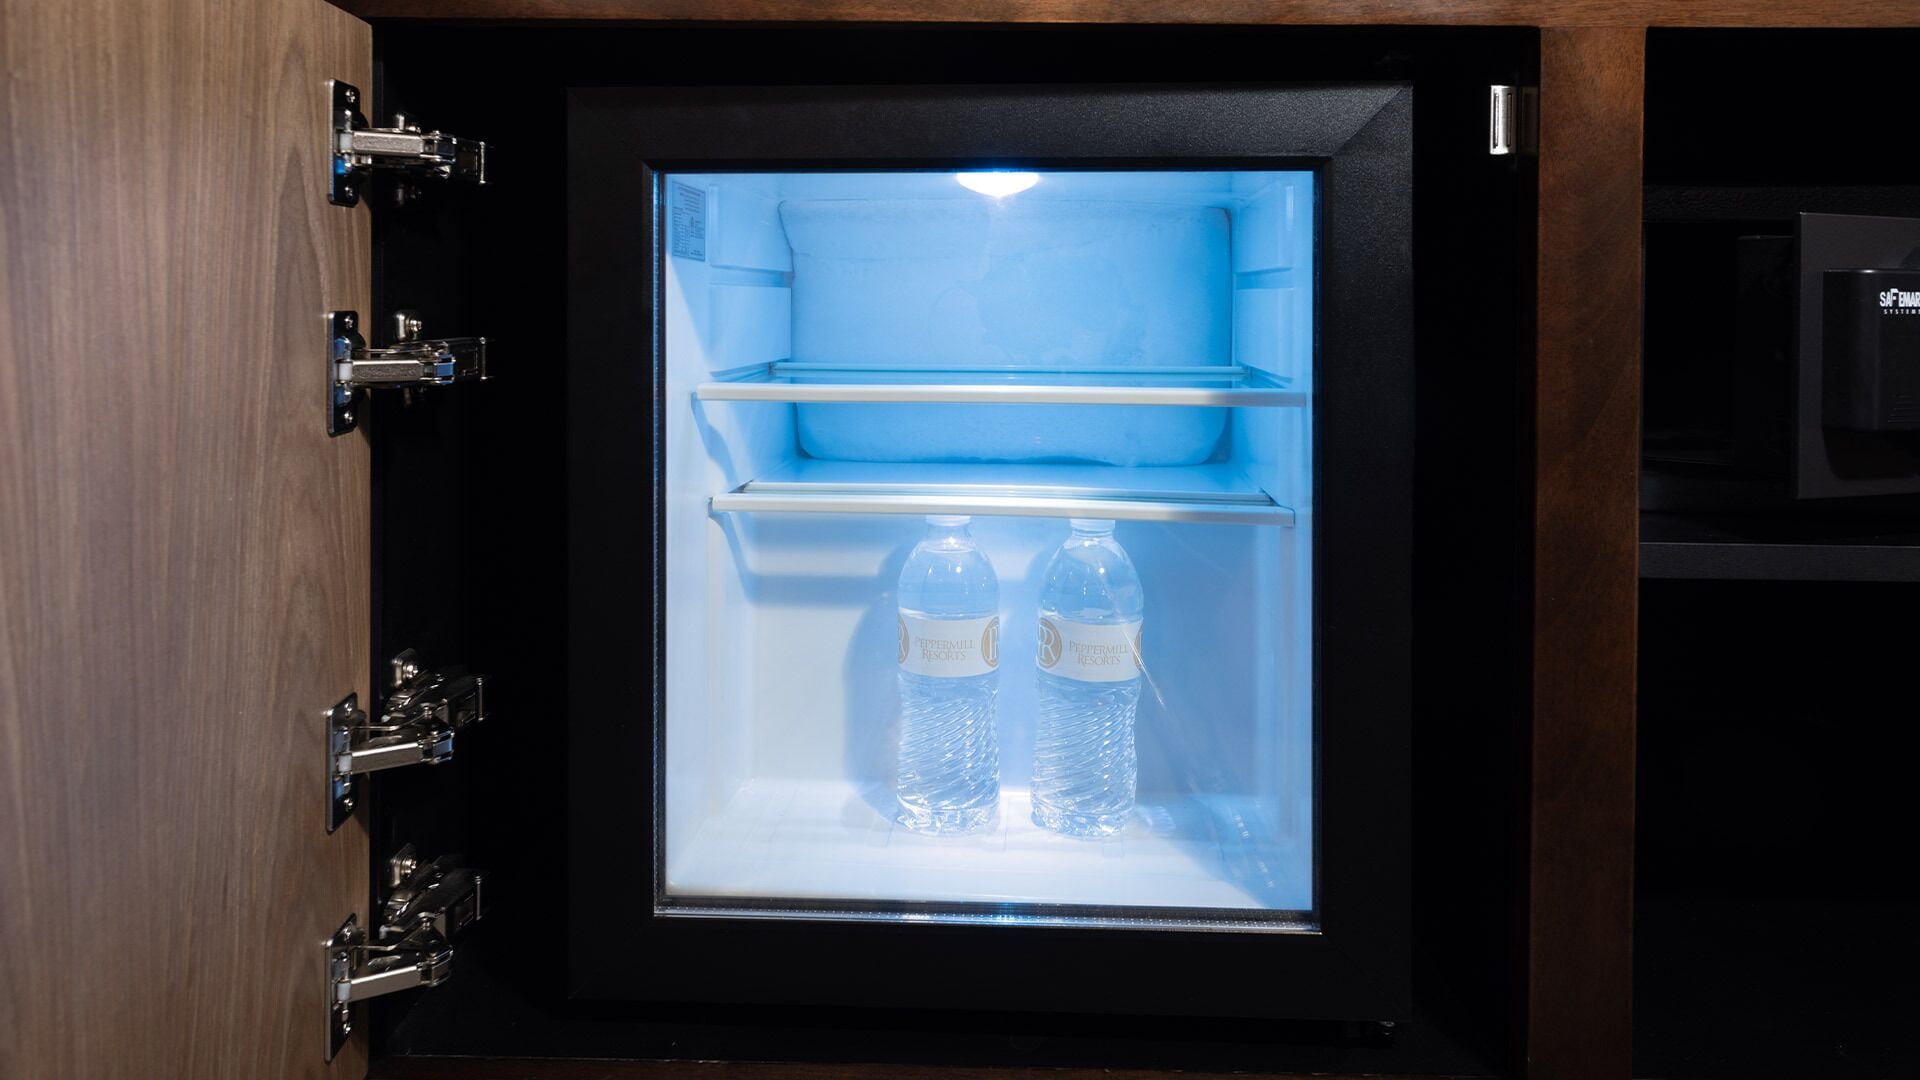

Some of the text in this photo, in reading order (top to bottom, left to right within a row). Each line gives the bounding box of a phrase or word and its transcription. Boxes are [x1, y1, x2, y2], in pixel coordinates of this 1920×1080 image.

[914, 636, 976, 650] PEPPERMILL
[1069, 640, 1129, 655] PEPPERMILL
[922, 649, 967, 663] RESORTS
[1077, 653, 1121, 667] RESORTS
